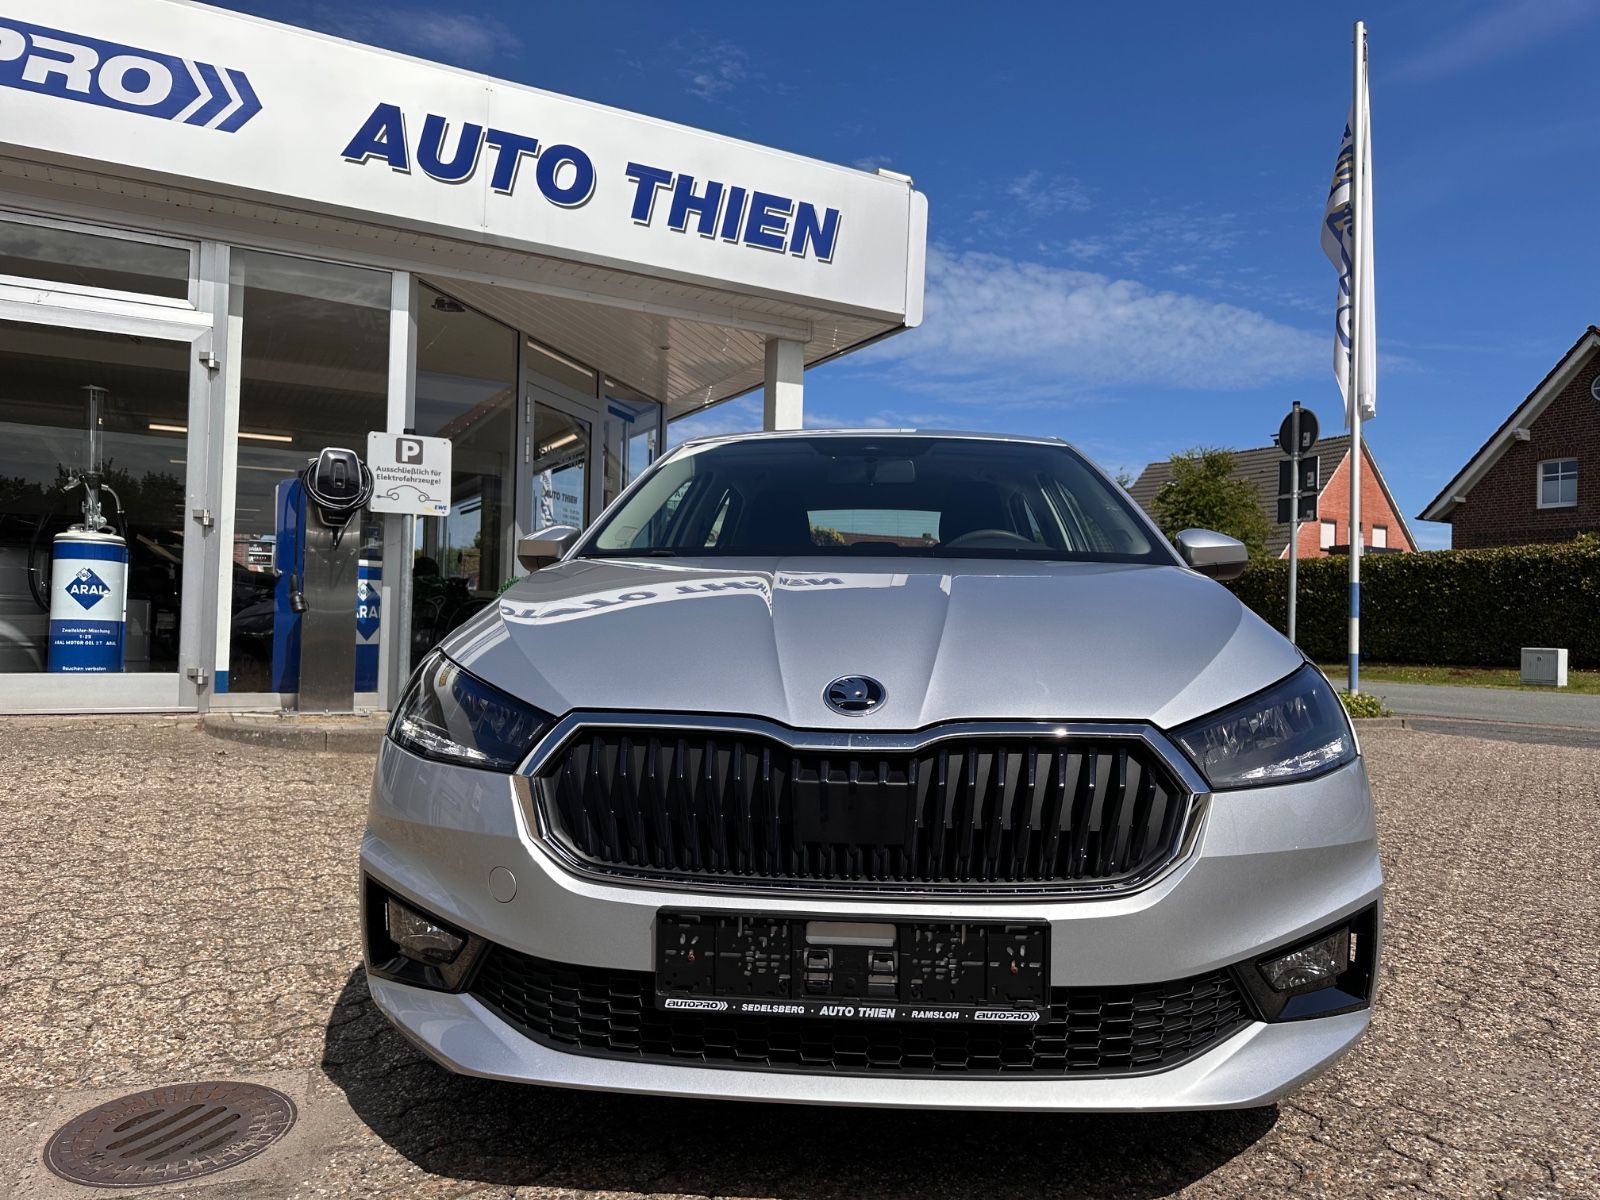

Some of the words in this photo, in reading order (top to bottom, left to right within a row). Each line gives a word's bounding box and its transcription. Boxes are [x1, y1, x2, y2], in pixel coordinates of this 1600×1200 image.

[340, 102, 595, 208] AUTO
[625, 161, 841, 263] THIEN
[402, 440, 420, 462] P
[376, 466, 429, 476] Ausschließlich
[376, 474, 441, 486] Elektrofahrzeuge!
[70, 584, 104, 595] ARAL
[741, 1003, 805, 1014] SEDELSBERG
[819, 1005, 855, 1017] AUTO
[858, 1007, 896, 1018] THIEN
[911, 1010, 960, 1019] RAMSLOH
